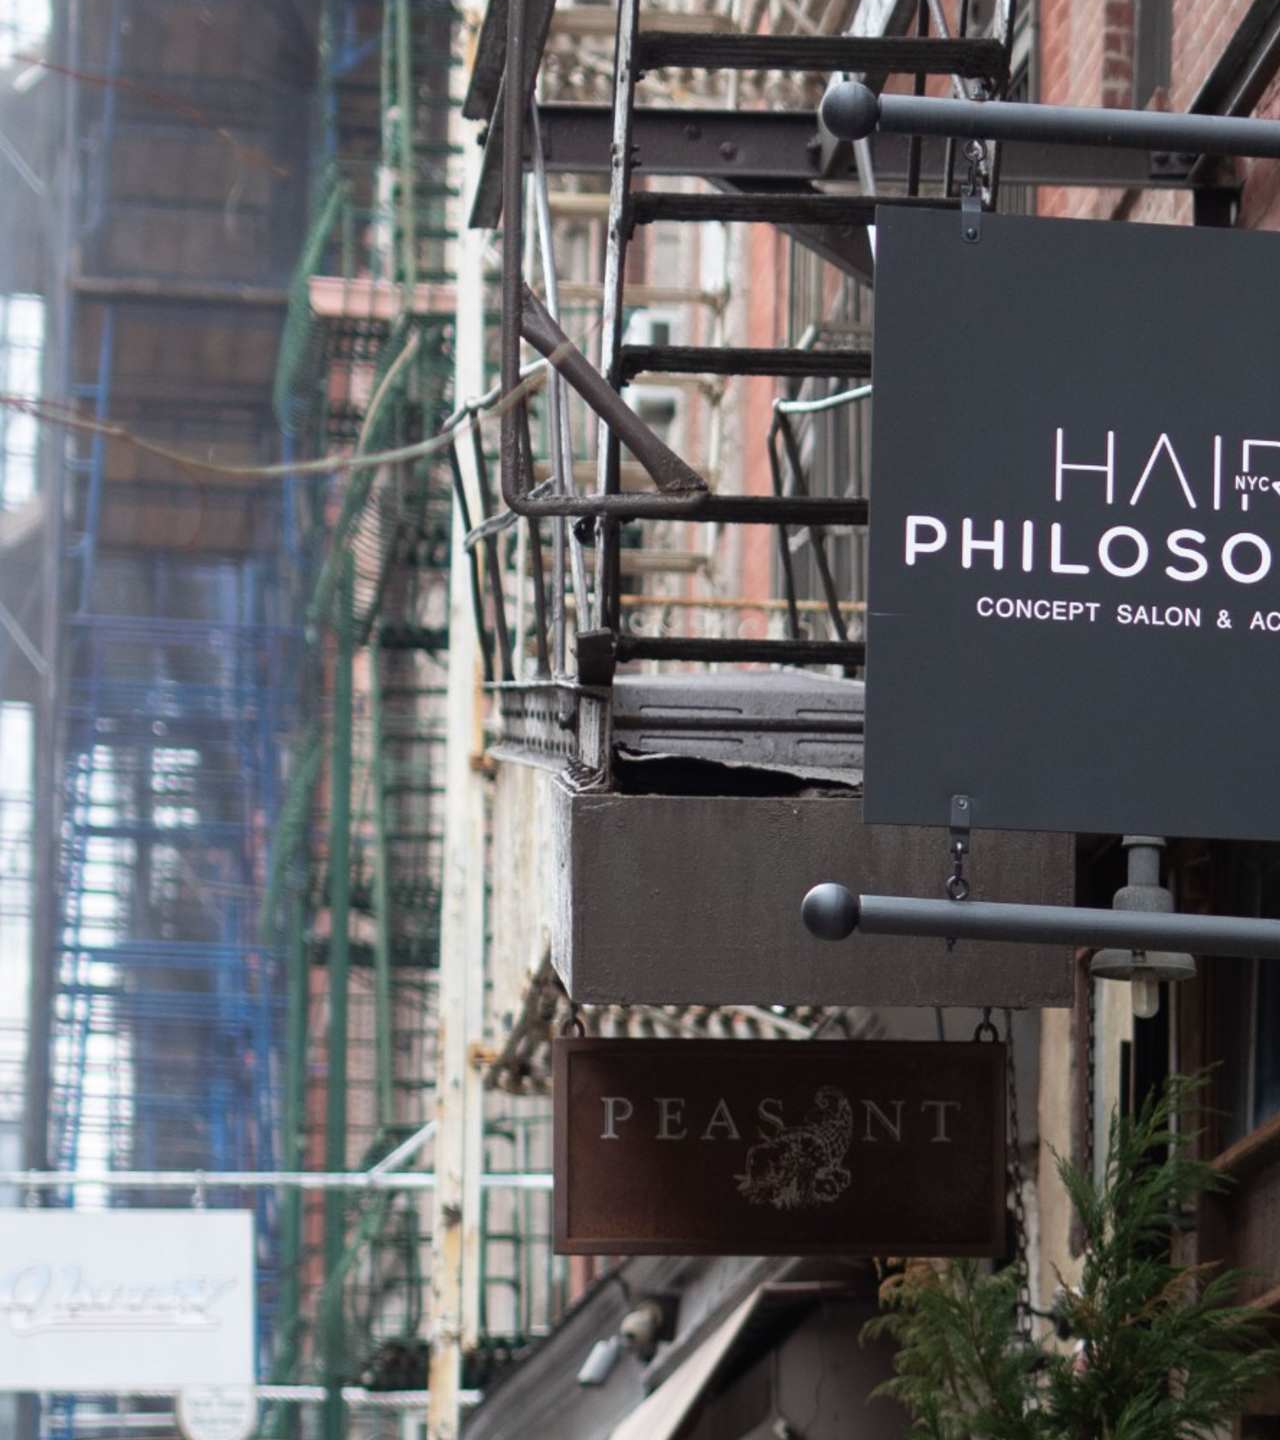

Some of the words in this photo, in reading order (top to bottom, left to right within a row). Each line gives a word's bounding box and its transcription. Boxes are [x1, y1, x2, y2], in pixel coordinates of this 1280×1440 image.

[1235, 474, 1270, 492] NYC
[976, 596, 1101, 623] CONCEPT
[1116, 604, 1201, 628] SALON
[1216, 609, 1232, 630] &
[600, 1096, 962, 1144] PEASNT
